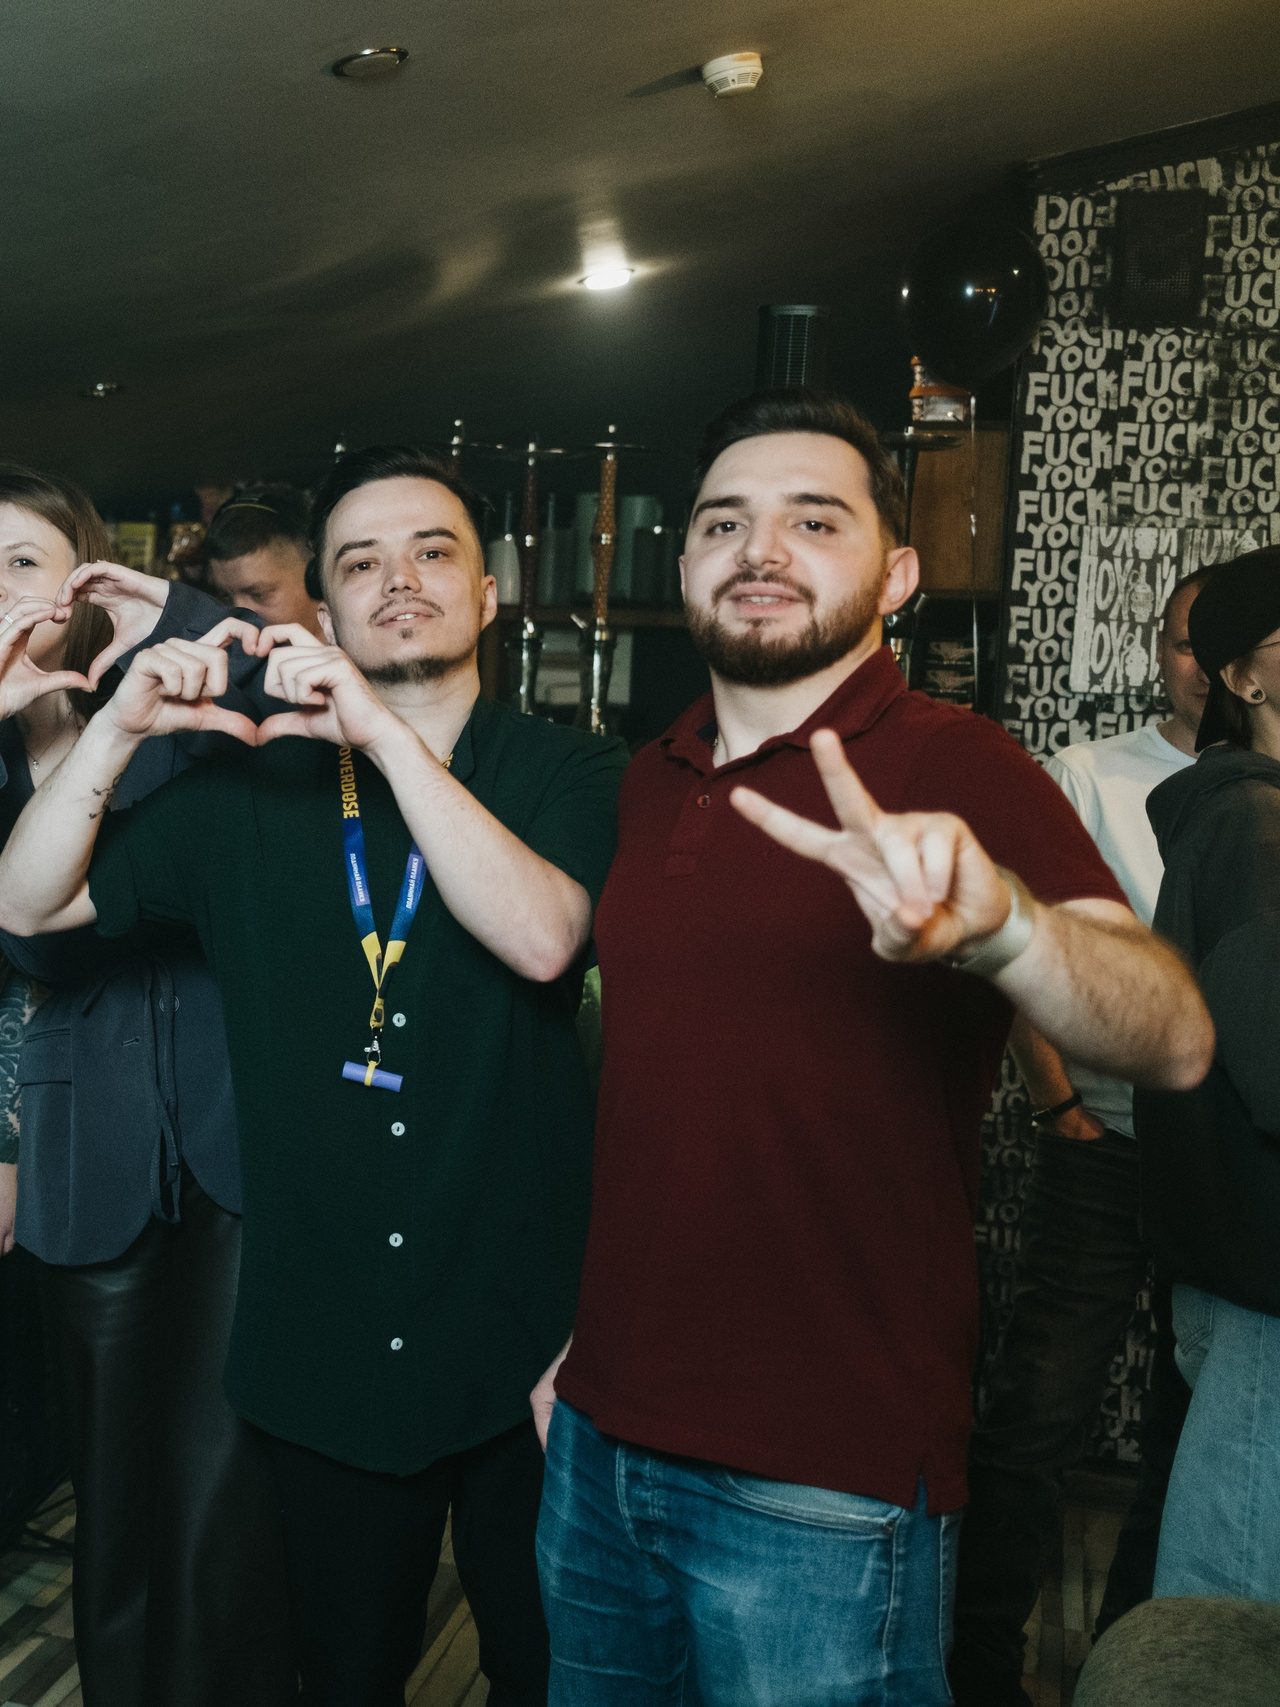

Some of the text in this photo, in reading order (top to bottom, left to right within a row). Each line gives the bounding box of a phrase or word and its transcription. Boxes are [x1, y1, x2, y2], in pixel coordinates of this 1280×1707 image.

[1204, 210, 1280, 258] FUC
[1198, 271, 1280, 318] FUC
[1041, 344, 1107, 373] YOU
[1138, 333, 1207, 363] YOU
[1207, 337, 1280, 373] FUC
[1025, 368, 1119, 415] FUCK
[1120, 359, 1220, 408] FUCK
[1036, 404, 1102, 433] YOU
[1130, 396, 1198, 424] YOU
[1205, 396, 1280, 433] FUC
[1020, 429, 1113, 475] FUCK
[1113, 421, 1214, 467] FUCK
[1031, 463, 1097, 491] YOU
[1124, 455, 1192, 483] YOU
[1200, 455, 1280, 491] FUC
[1016, 488, 1109, 534] FUCK
[1110, 481, 1209, 519] FUCK
[1211, 488, 1280, 515] YOU
[1010, 548, 1080, 592] FUC
[1008, 605, 1076, 647] FUC
[1004, 664, 1073, 704] FUC
[1015, 694, 1080, 721] YOU
[338, 745, 360, 819] OVERDOSE
